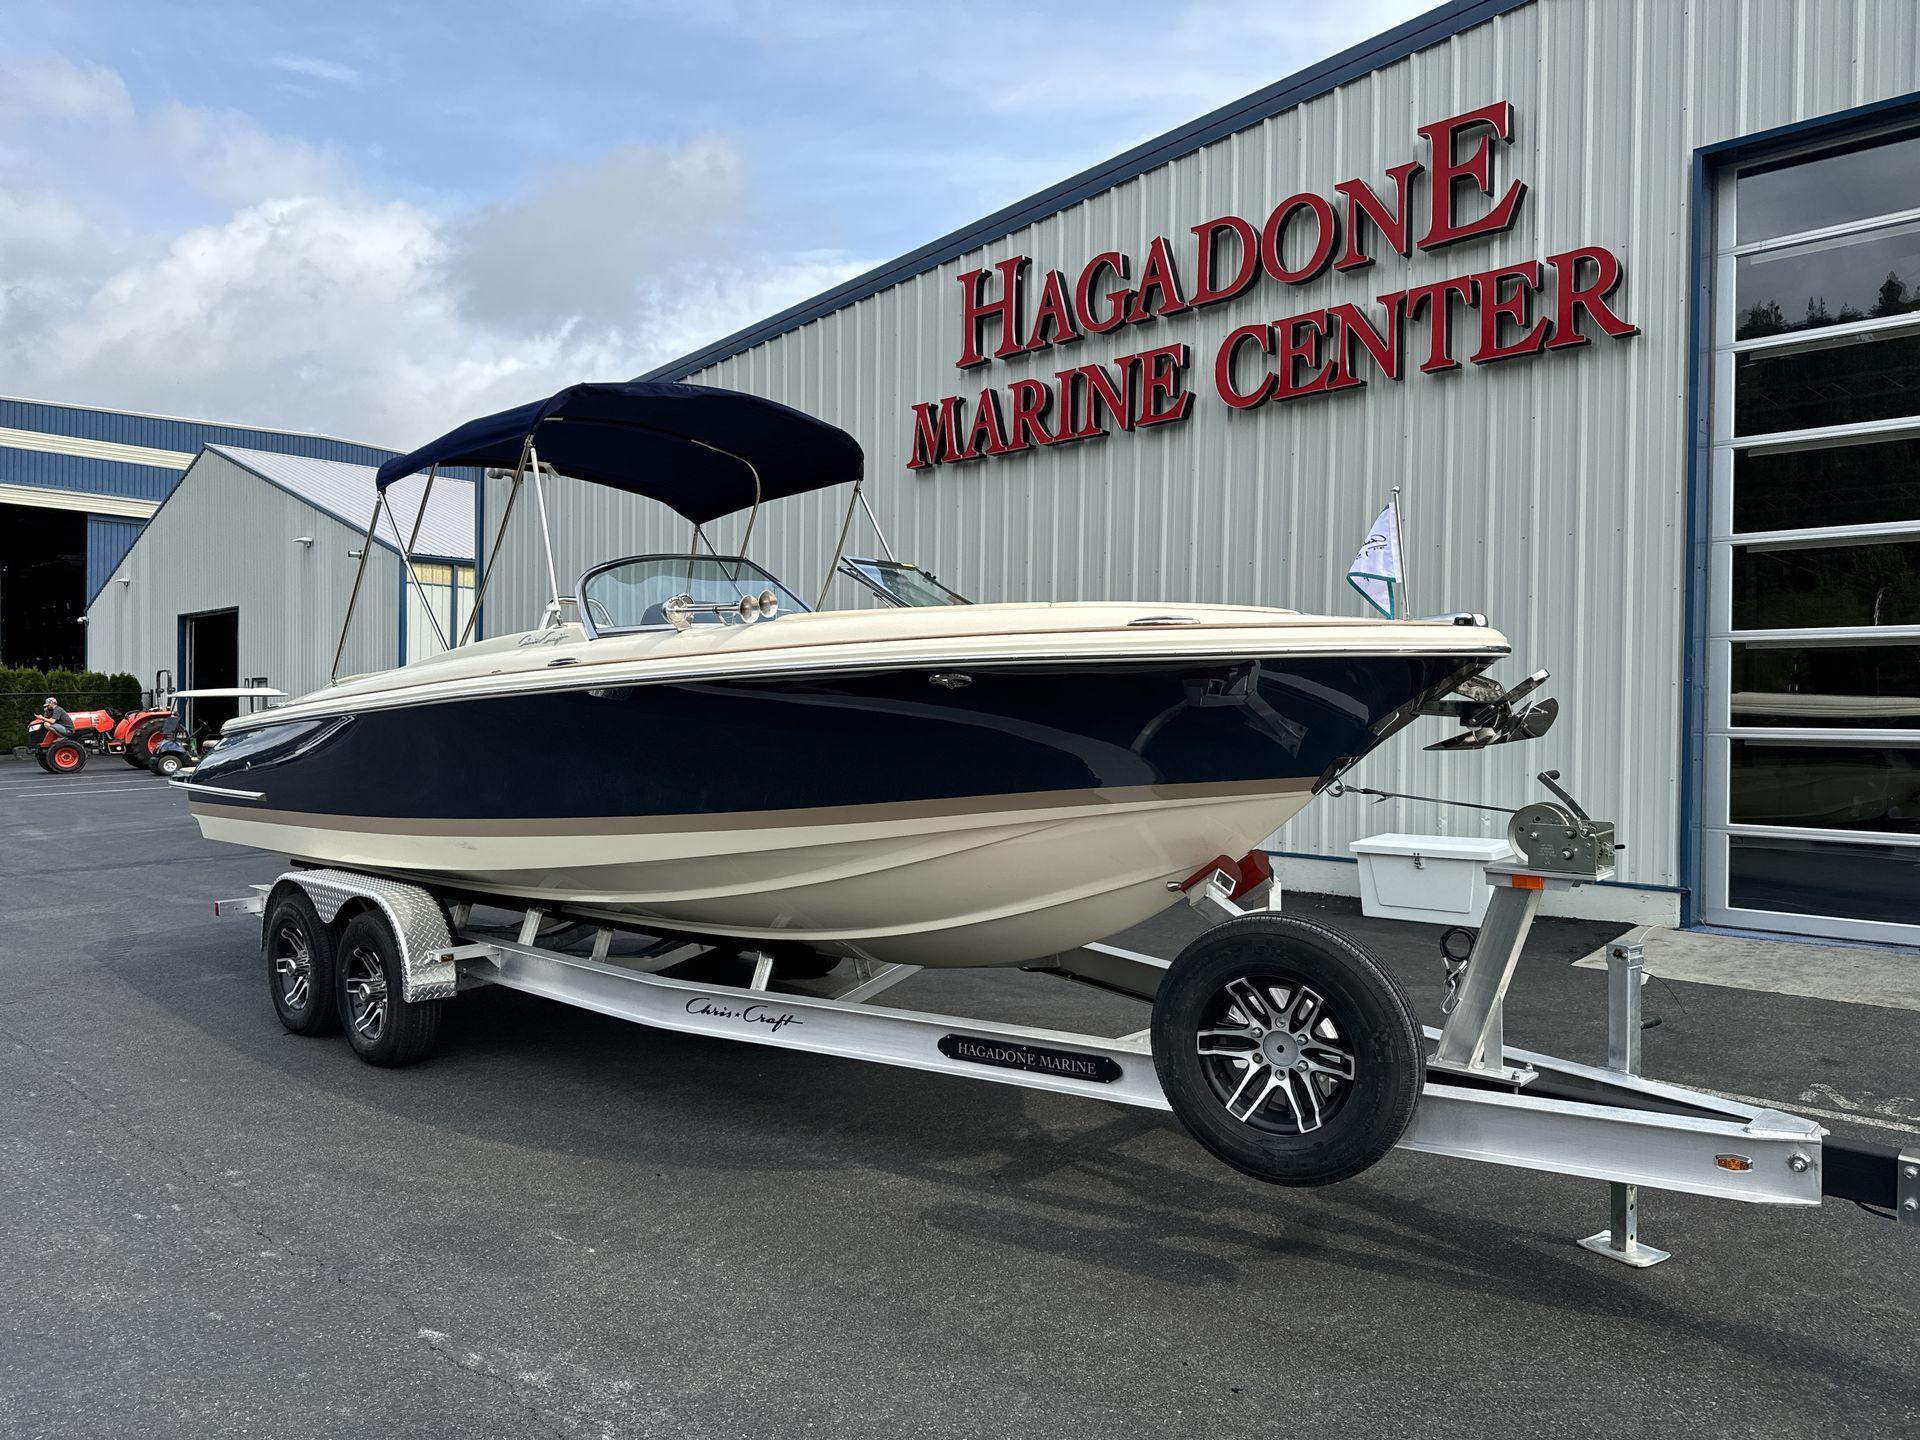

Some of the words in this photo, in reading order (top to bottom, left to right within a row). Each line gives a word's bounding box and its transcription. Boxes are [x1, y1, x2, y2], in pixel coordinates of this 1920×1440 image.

[956, 101, 1528, 369] HAGADONE
[906, 342, 1196, 471] MARINE
[1214, 246, 1640, 411] CENTER
[685, 997, 732, 1018] Chris
[743, 1004, 803, 1032] Craft
[957, 1042, 1036, 1066] HAGADONE
[1039, 1055, 1097, 1075] MARINE
